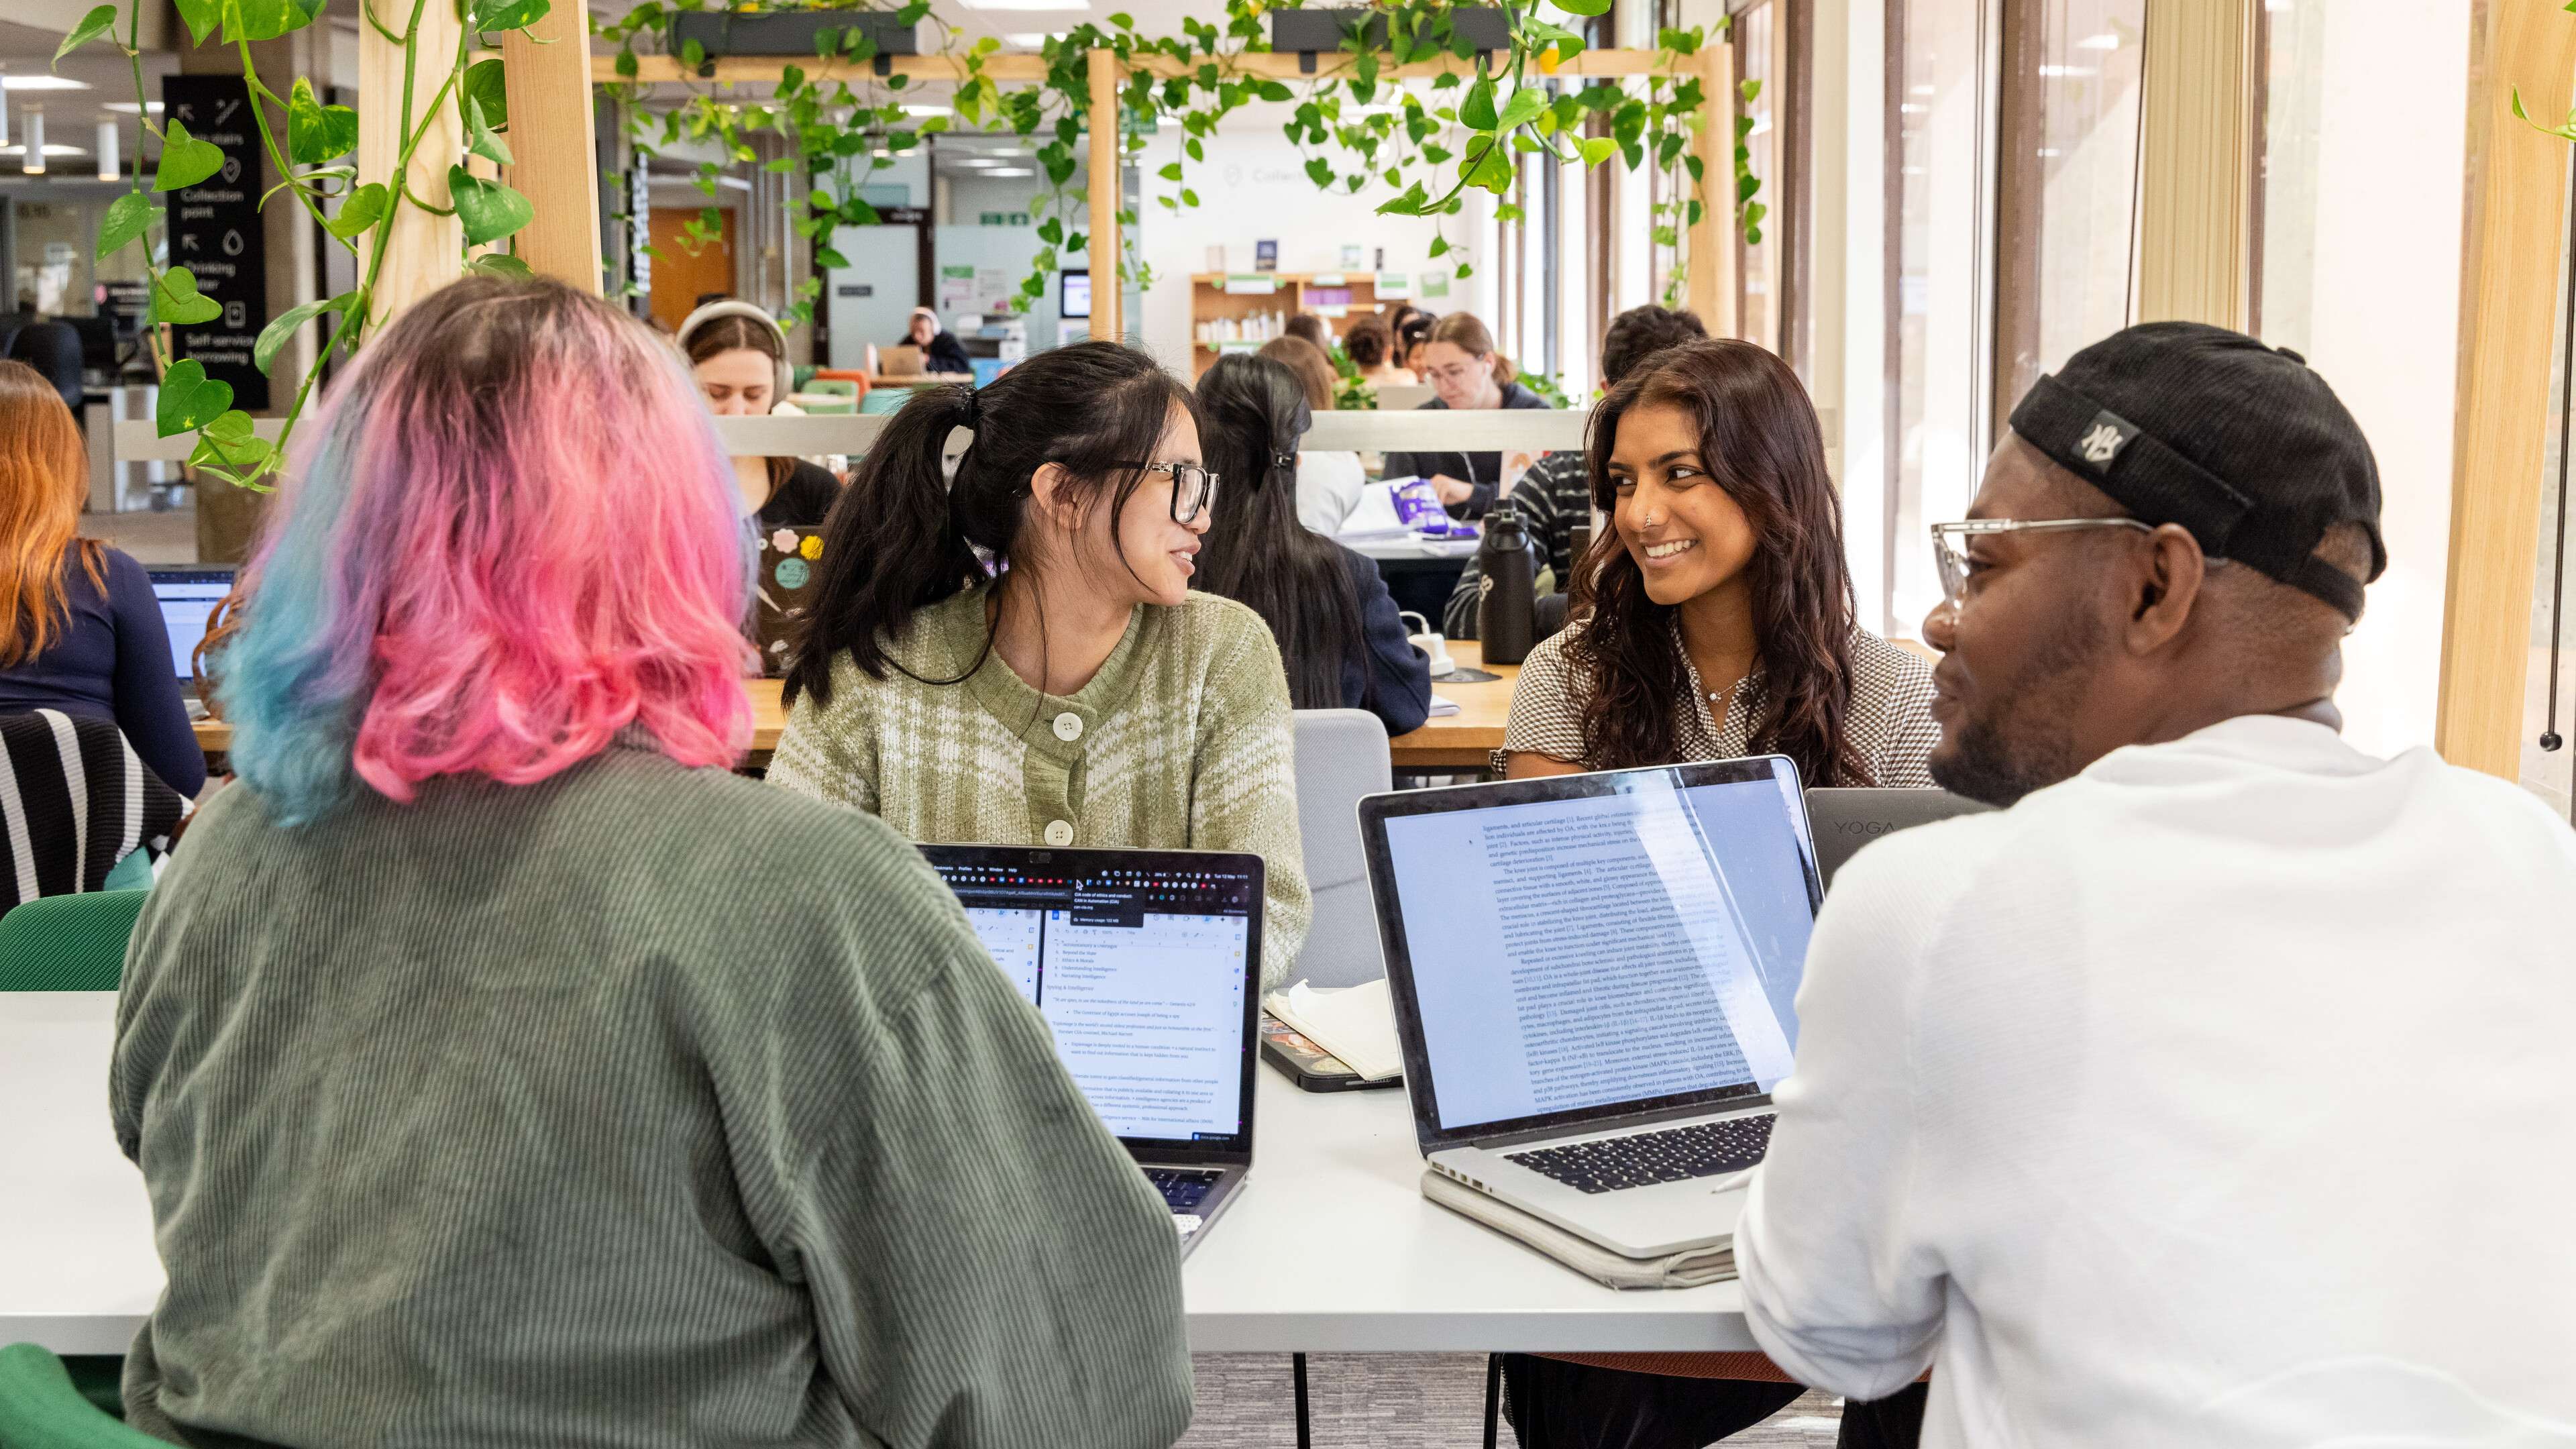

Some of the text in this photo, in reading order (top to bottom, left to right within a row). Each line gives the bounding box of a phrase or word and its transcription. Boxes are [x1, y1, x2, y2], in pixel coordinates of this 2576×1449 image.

[180, 189, 244, 203] Collection
[180, 207, 215, 221] point
[185, 350, 249, 366] borrowing
[1835, 822, 1896, 835] YOGA
